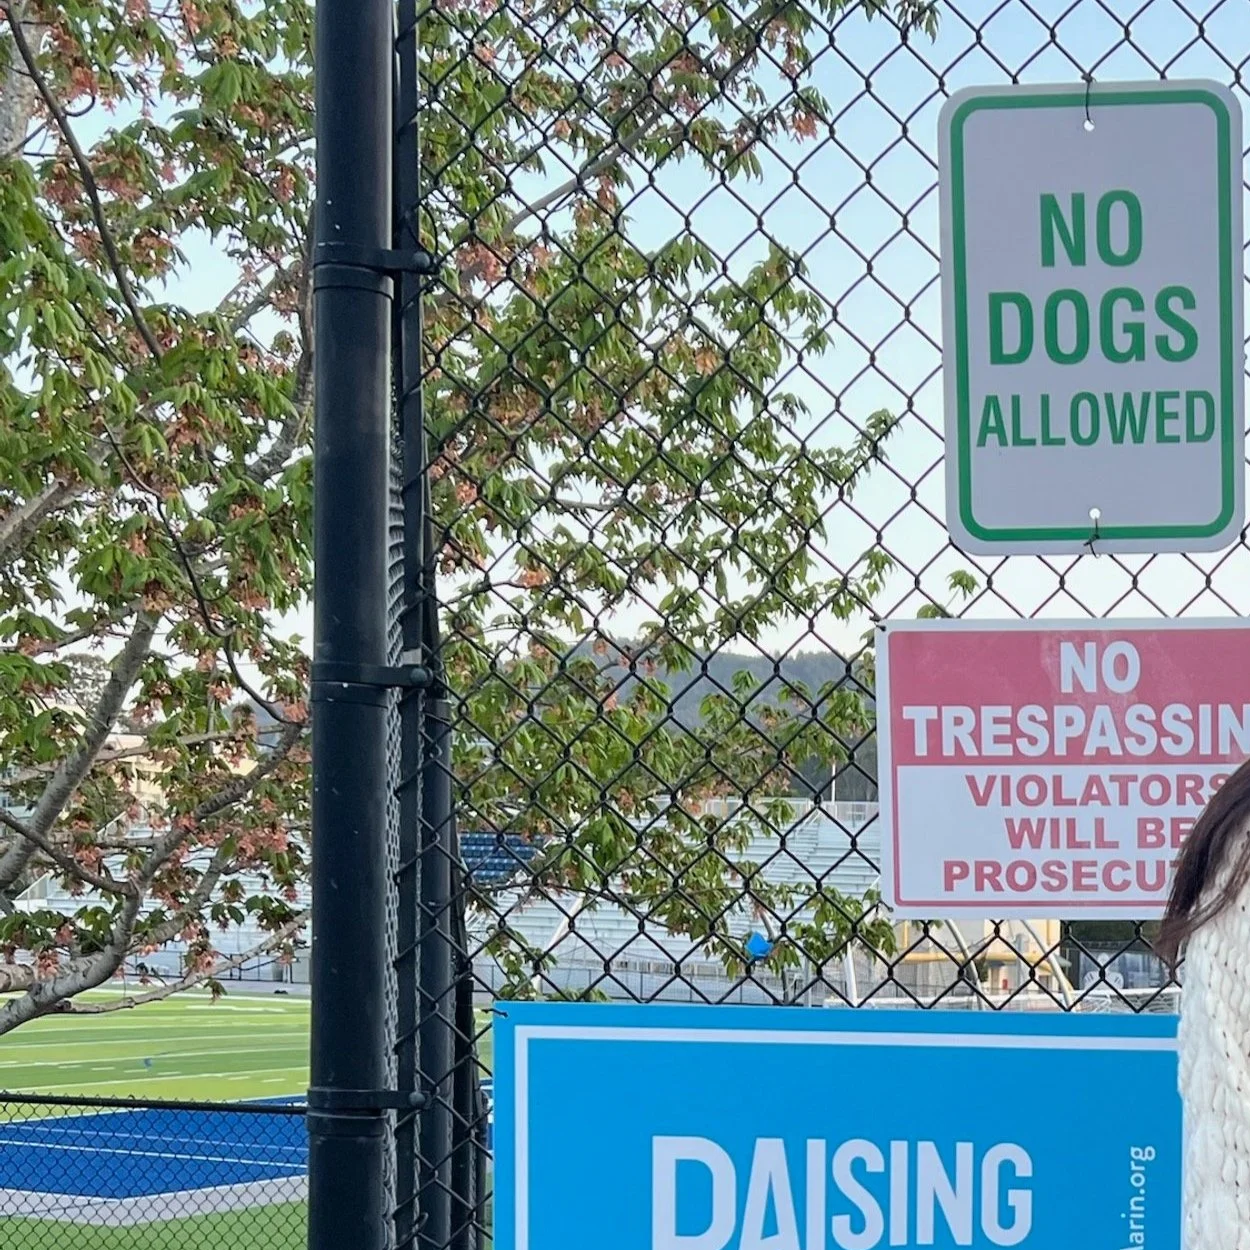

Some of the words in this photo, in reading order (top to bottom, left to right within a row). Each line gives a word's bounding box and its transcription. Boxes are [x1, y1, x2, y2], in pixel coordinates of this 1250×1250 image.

[1039, 189, 1144, 268] NO
[987, 285, 1200, 366] DOGS
[975, 389, 1217, 448] ALLOWED
[1060, 640, 1142, 694] NO
[1004, 817, 1119, 850] WILL
[1136, 817, 1196, 849] BE
[943, 860, 1179, 893] PROSECU
